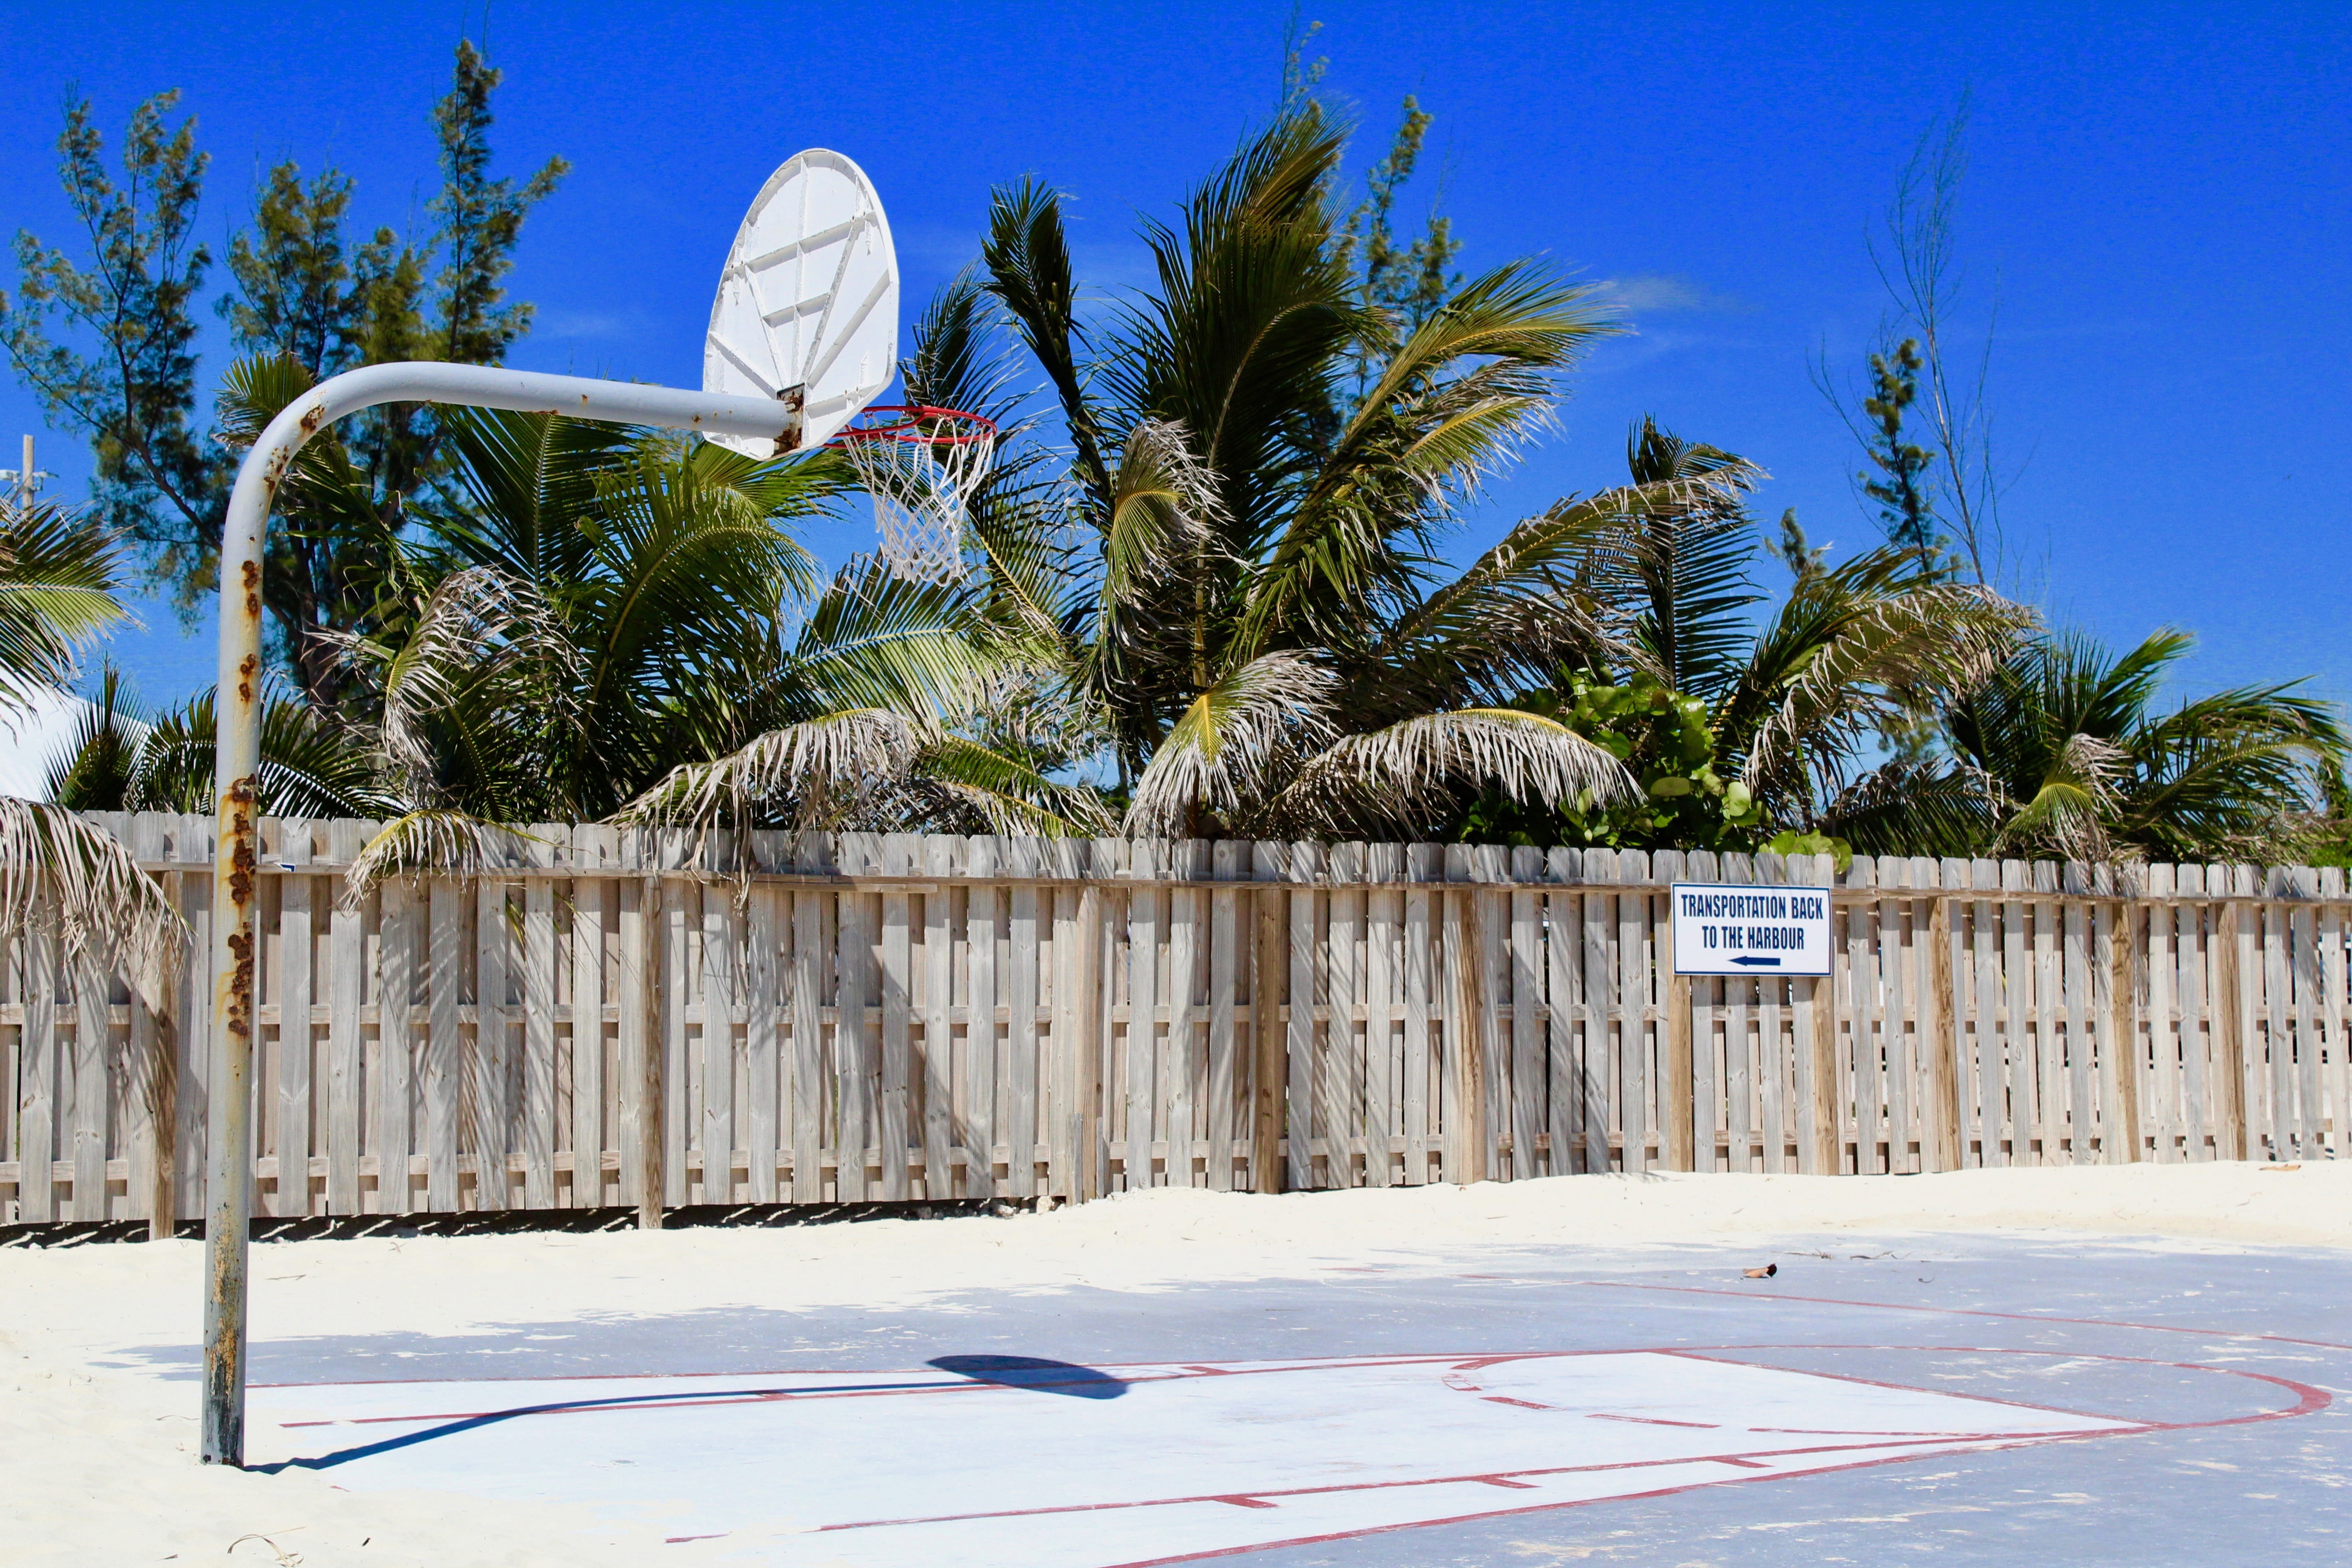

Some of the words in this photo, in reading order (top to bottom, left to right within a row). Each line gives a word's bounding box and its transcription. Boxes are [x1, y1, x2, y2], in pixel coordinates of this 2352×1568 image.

[1681, 894, 1786, 919] TRANSPORTATION
[1791, 897, 1823, 920] BACK
[1702, 926, 1717, 949] TO
[1721, 926, 1743, 949] THE
[1748, 927, 1804, 950] HARBOUR
